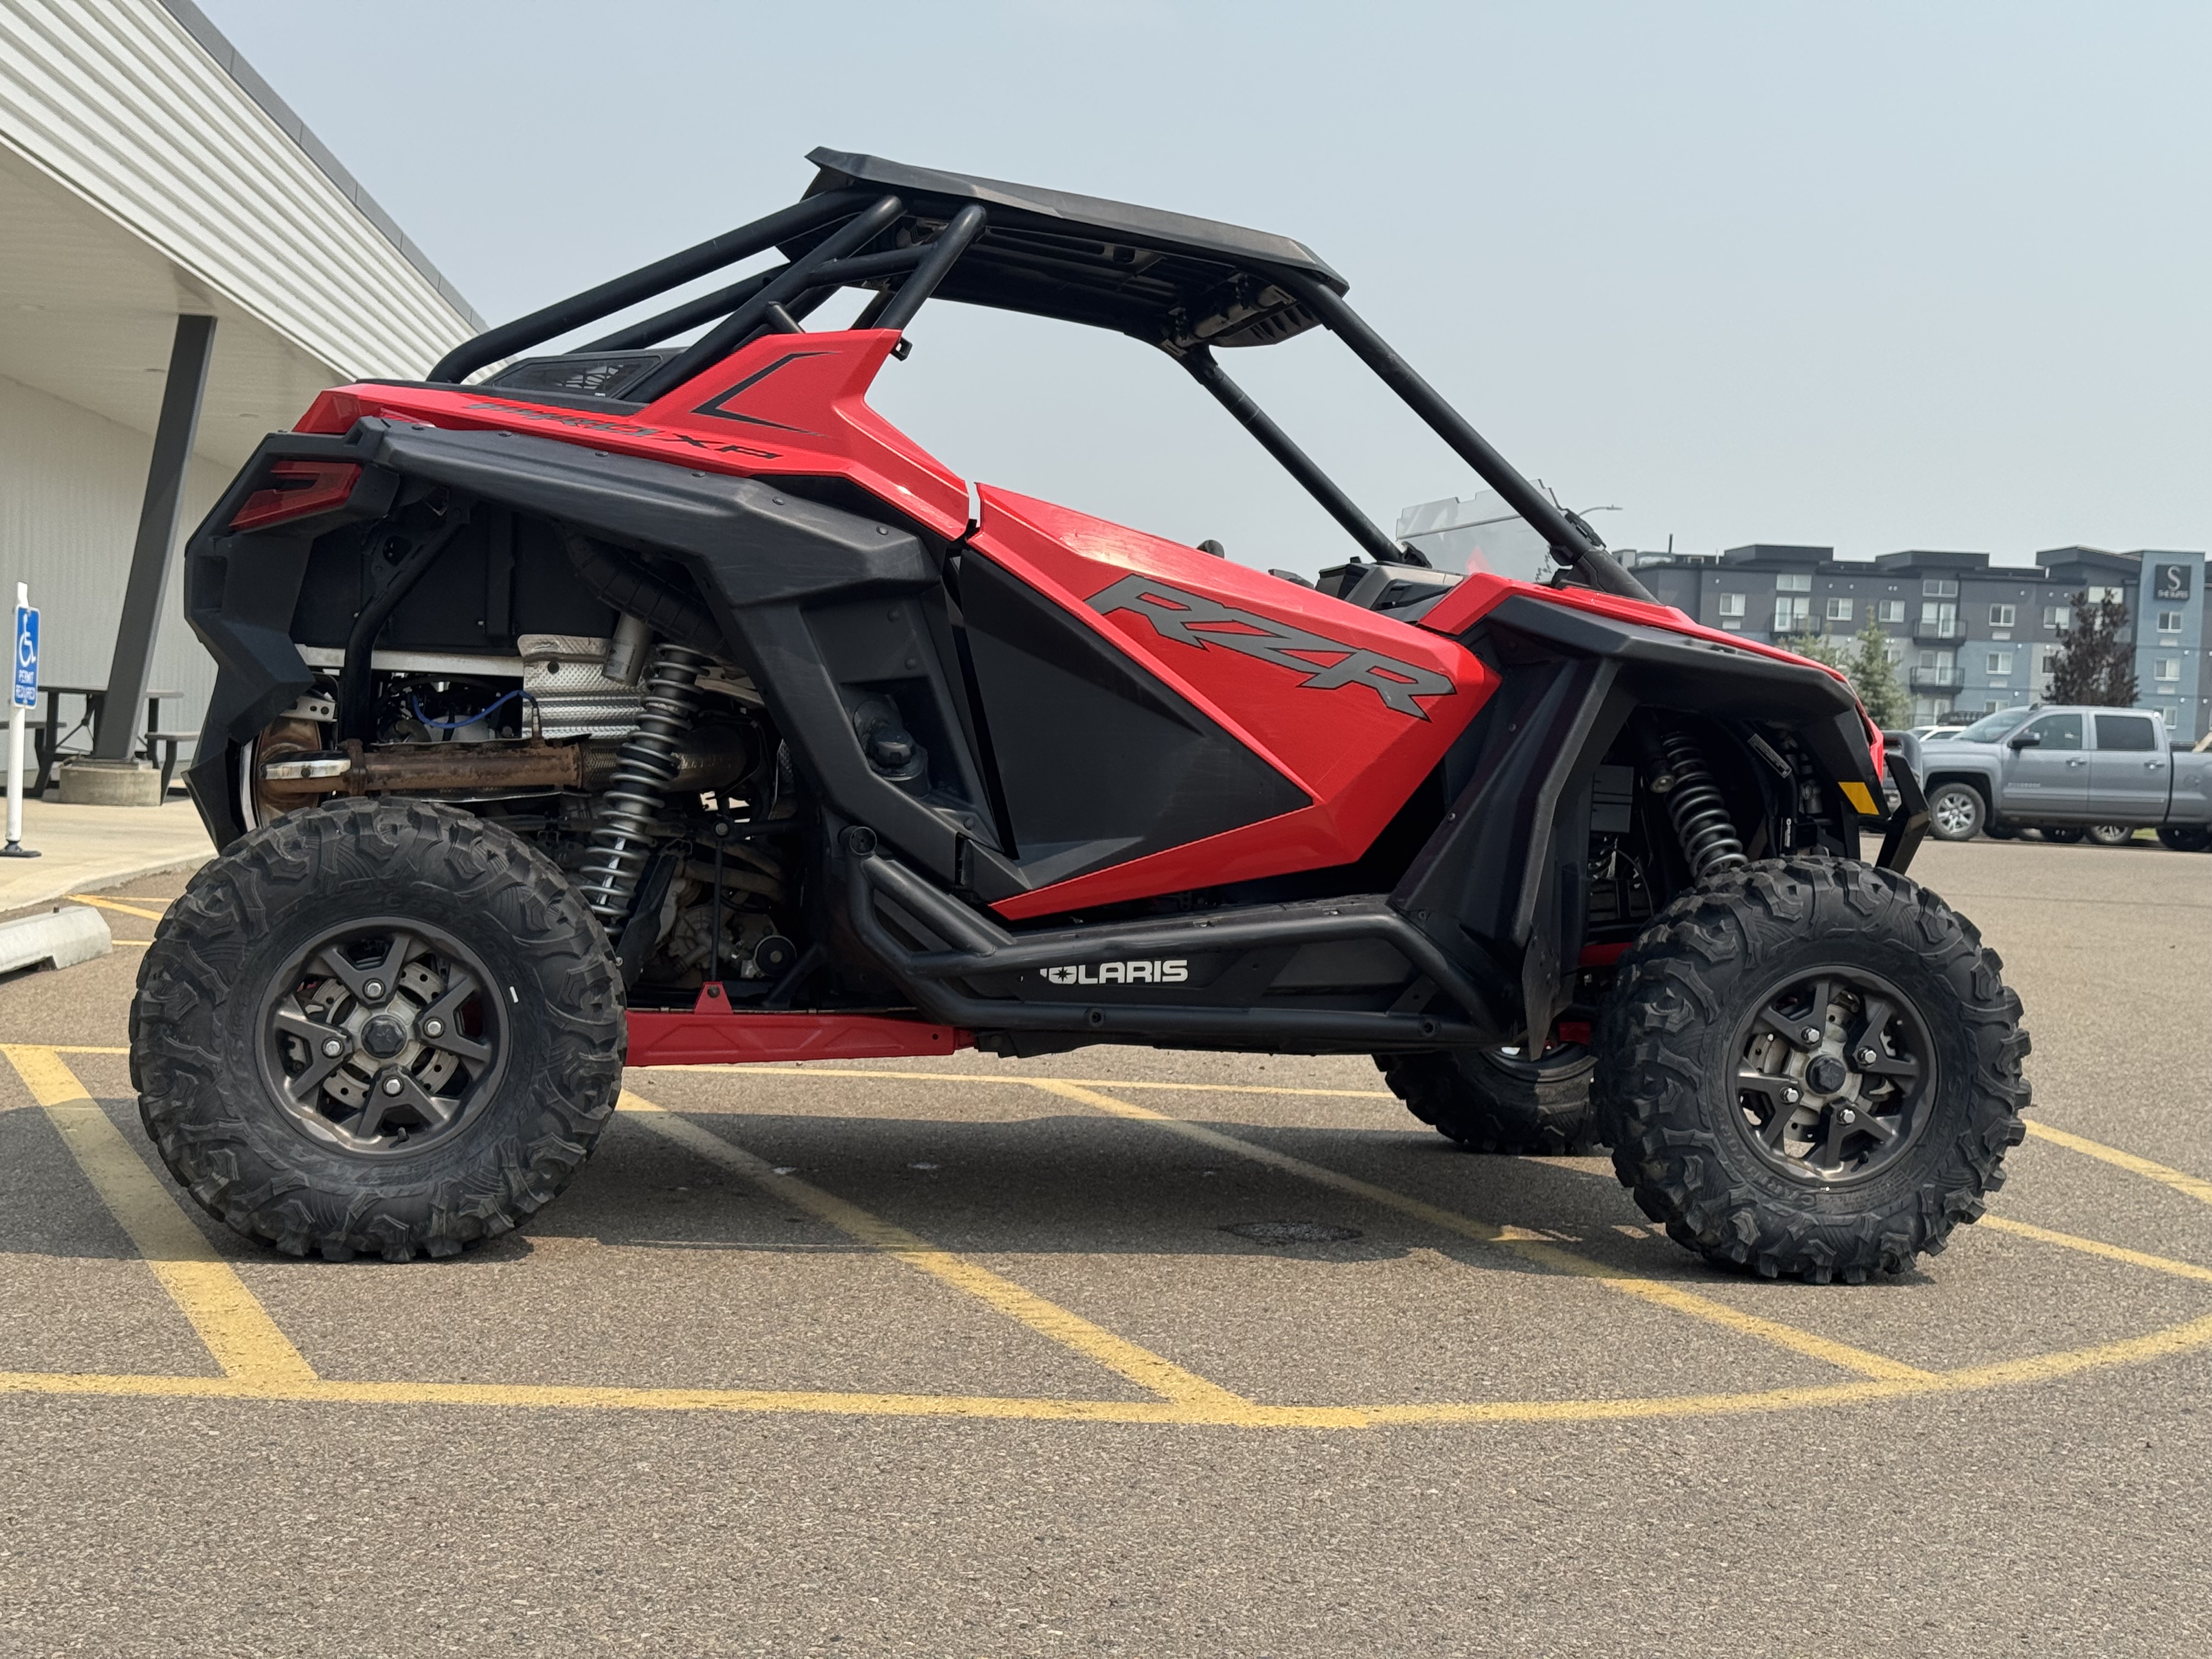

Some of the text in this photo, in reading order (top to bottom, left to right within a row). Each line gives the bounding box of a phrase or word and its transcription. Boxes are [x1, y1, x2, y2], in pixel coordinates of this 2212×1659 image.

[653, 432, 783, 459] XP
[2168, 566, 2181, 591] S
[1084, 573, 1457, 723] RZR
